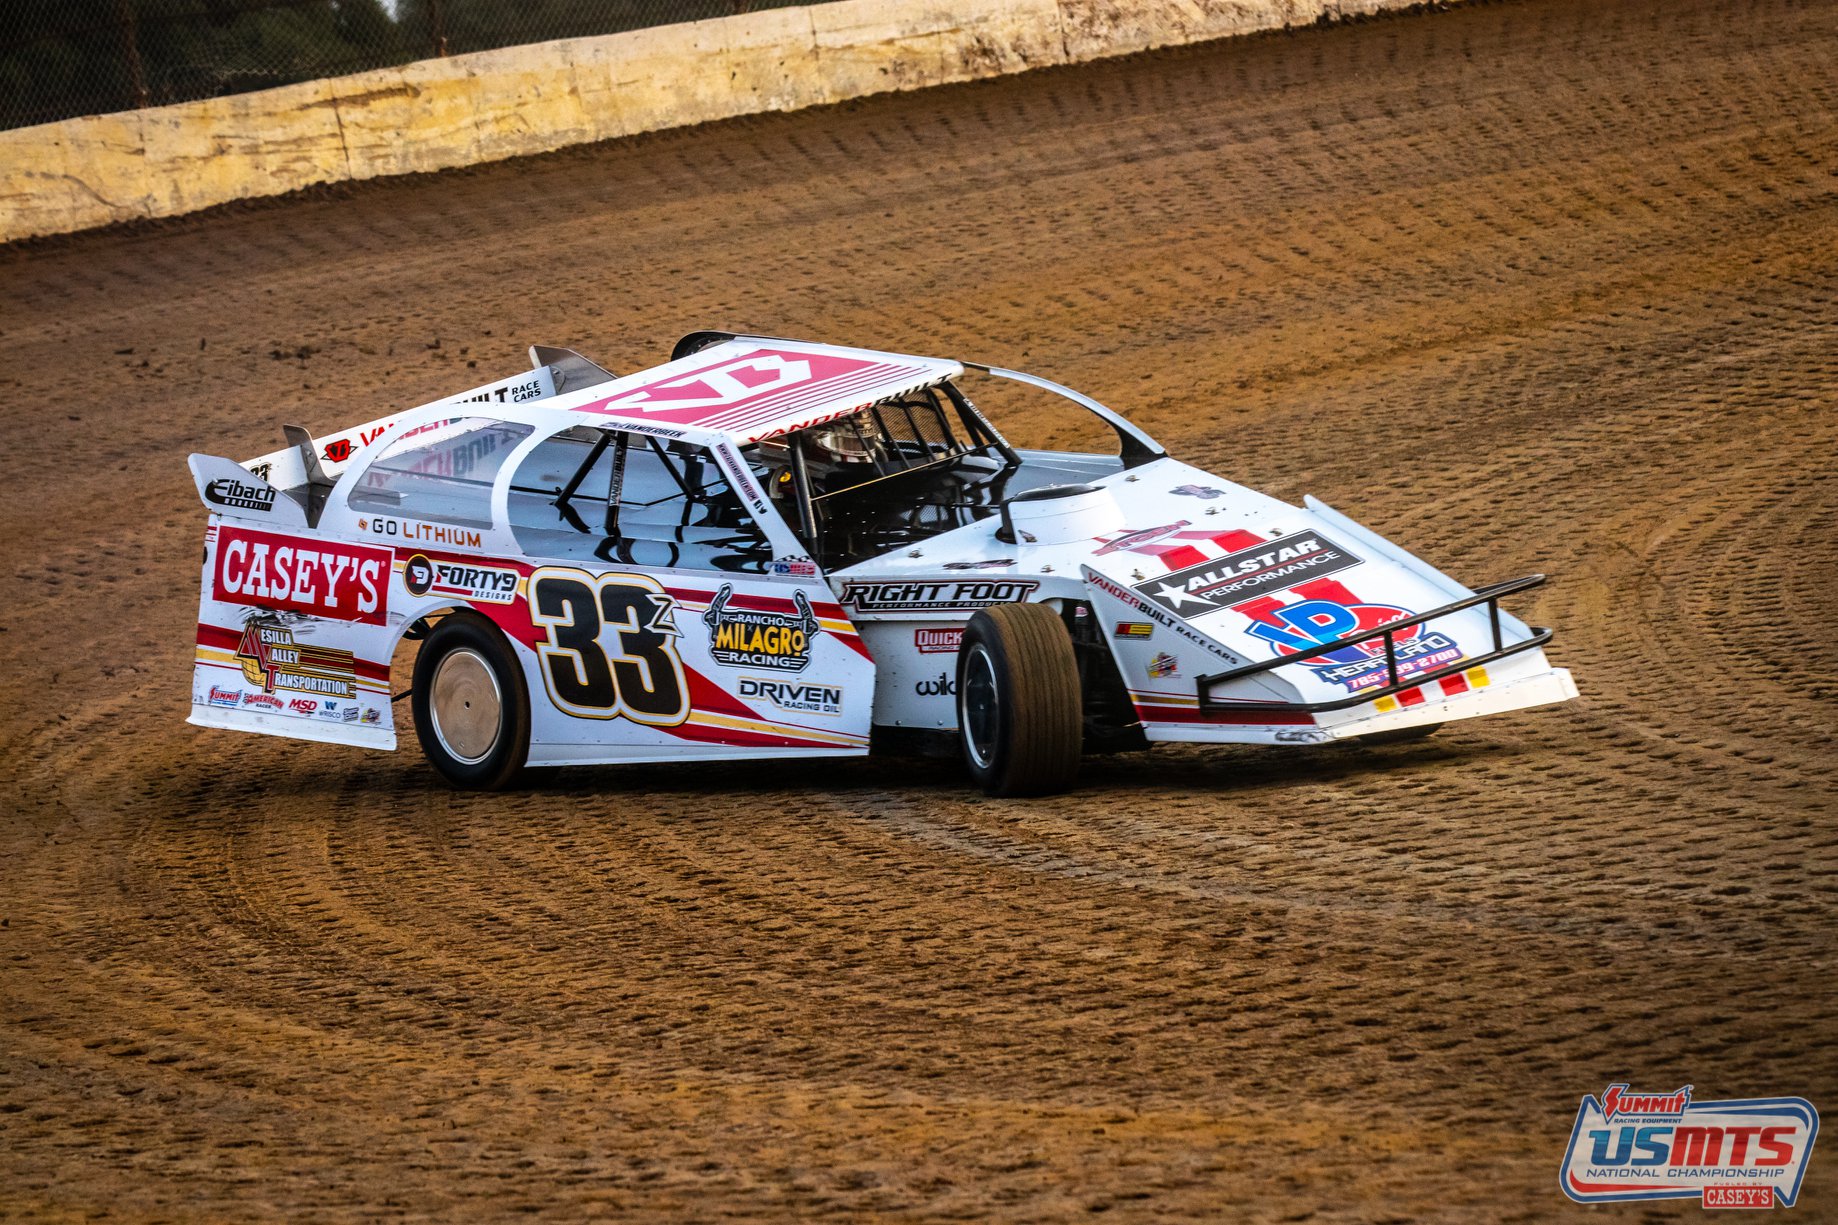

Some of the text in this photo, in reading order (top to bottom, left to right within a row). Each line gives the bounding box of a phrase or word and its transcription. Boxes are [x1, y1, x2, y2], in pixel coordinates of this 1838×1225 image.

[511, 380, 540, 395] RACE
[513, 388, 541, 403] CARS
[205, 479, 276, 512] Eibach
[373, 519, 482, 548] GO LITHIUM
[1188, 539, 1322, 590] ALLSTAR
[1200, 551, 1341, 600] PERFORMANCE
[222, 539, 381, 614] CASEY'S
[436, 565, 517, 592] FORTY9
[474, 590, 512, 601] DESIGNS
[844, 583, 1036, 604] RIGHT FOOT
[737, 614, 785, 627] RANCHO
[1088, 572, 1177, 628] VANDERBUILT
[1176, 625, 1207, 646] RACE
[1207, 644, 1239, 665] CARS
[715, 623, 805, 657] MILAGRO
[729, 652, 791, 667] RACING
[210, 687, 240, 702] SUMMIT
[739, 680, 841, 704] DRIVEN
[289, 699, 318, 710] MSD
[784, 701, 840, 713] RACING OIL
